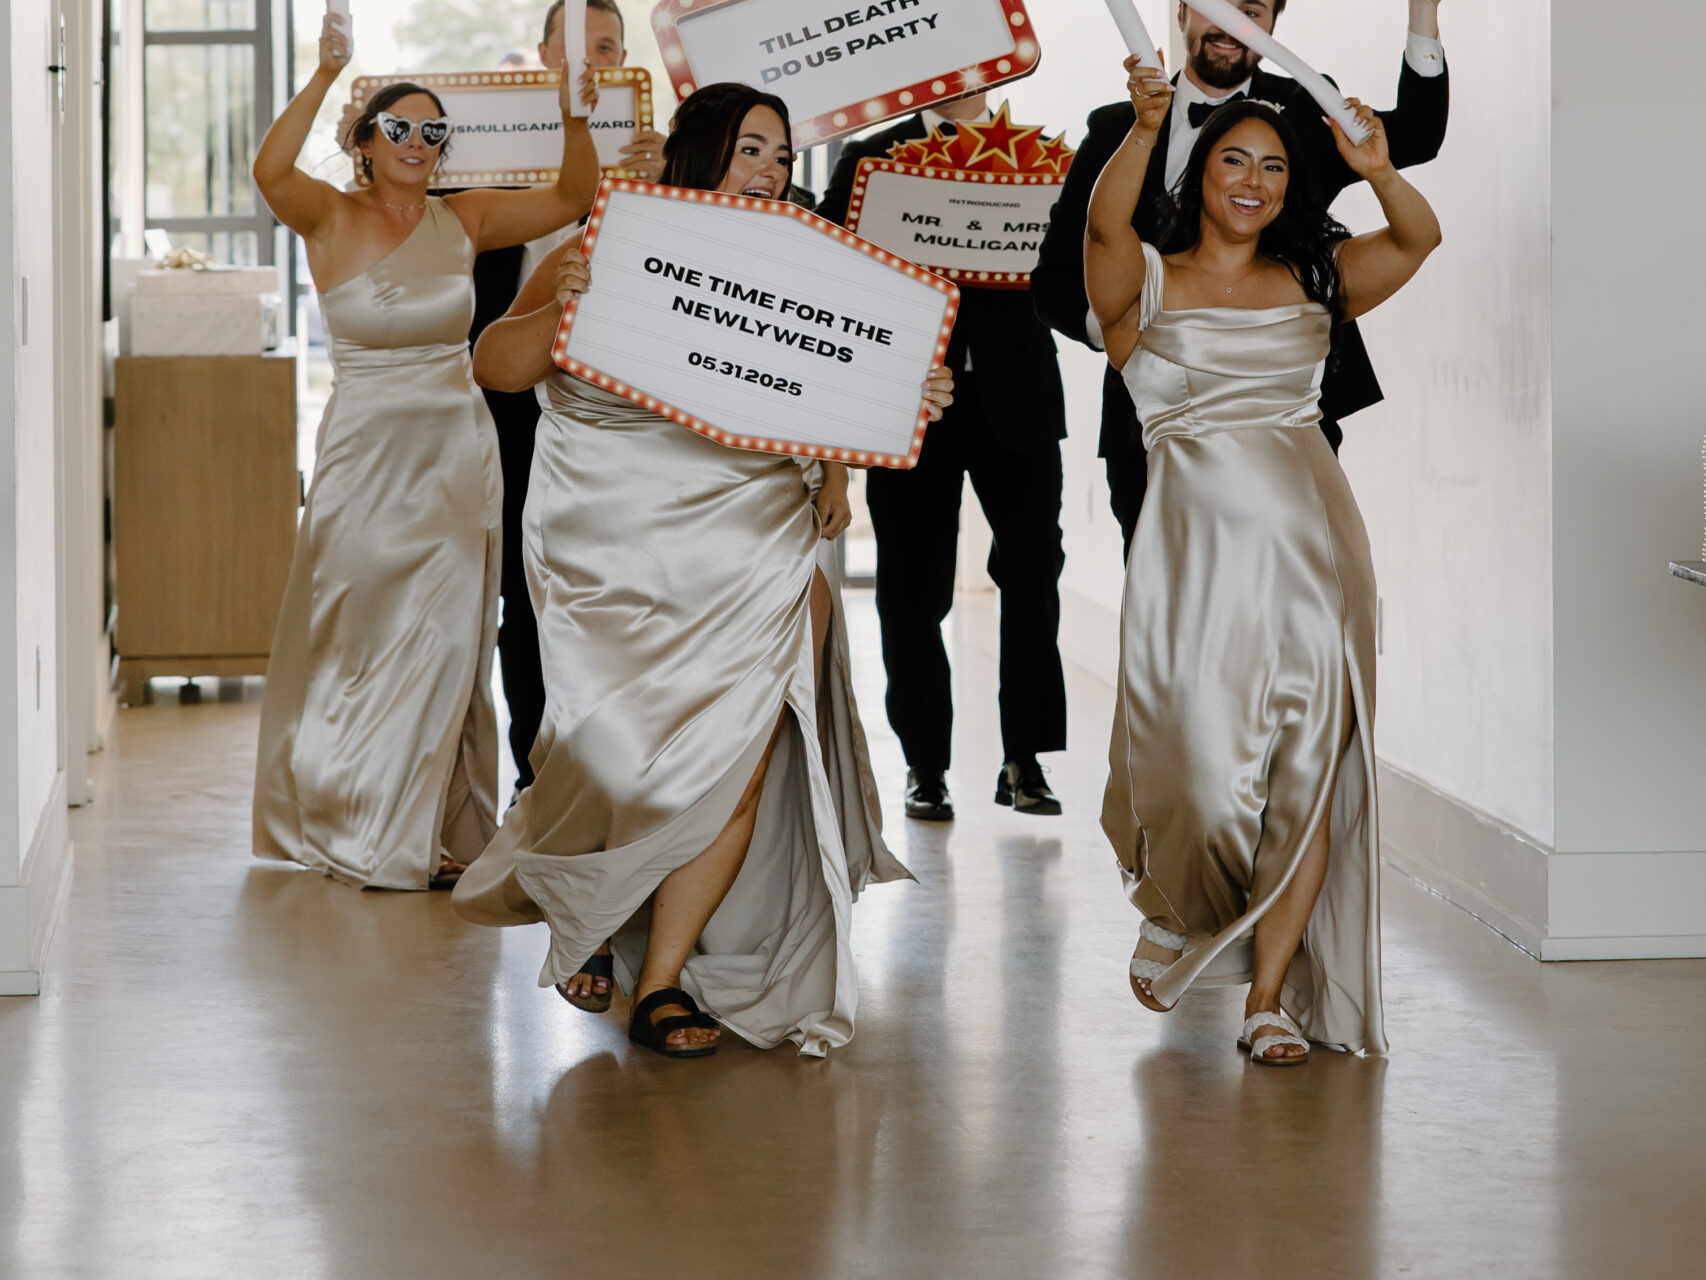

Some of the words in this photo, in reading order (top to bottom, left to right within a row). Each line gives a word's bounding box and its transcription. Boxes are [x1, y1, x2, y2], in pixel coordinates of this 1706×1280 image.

[759, 26, 821, 55] TILL
[760, 59, 801, 85] DO
[805, 46, 842, 68] US
[846, 13, 939, 56] PARTY
[948, 198, 1021, 209] INTRODUCING
[914, 232, 1037, 251] MULLIGAN
[966, 221, 982, 231] &
[644, 257, 702, 288] ONE
[708, 275, 776, 310] TIME
[779, 299, 835, 328] FOR
[840, 316, 893, 346] THE
[672, 295, 854, 363] NEWLYWEDS
[688, 351, 803, 396] 05.31.2025
